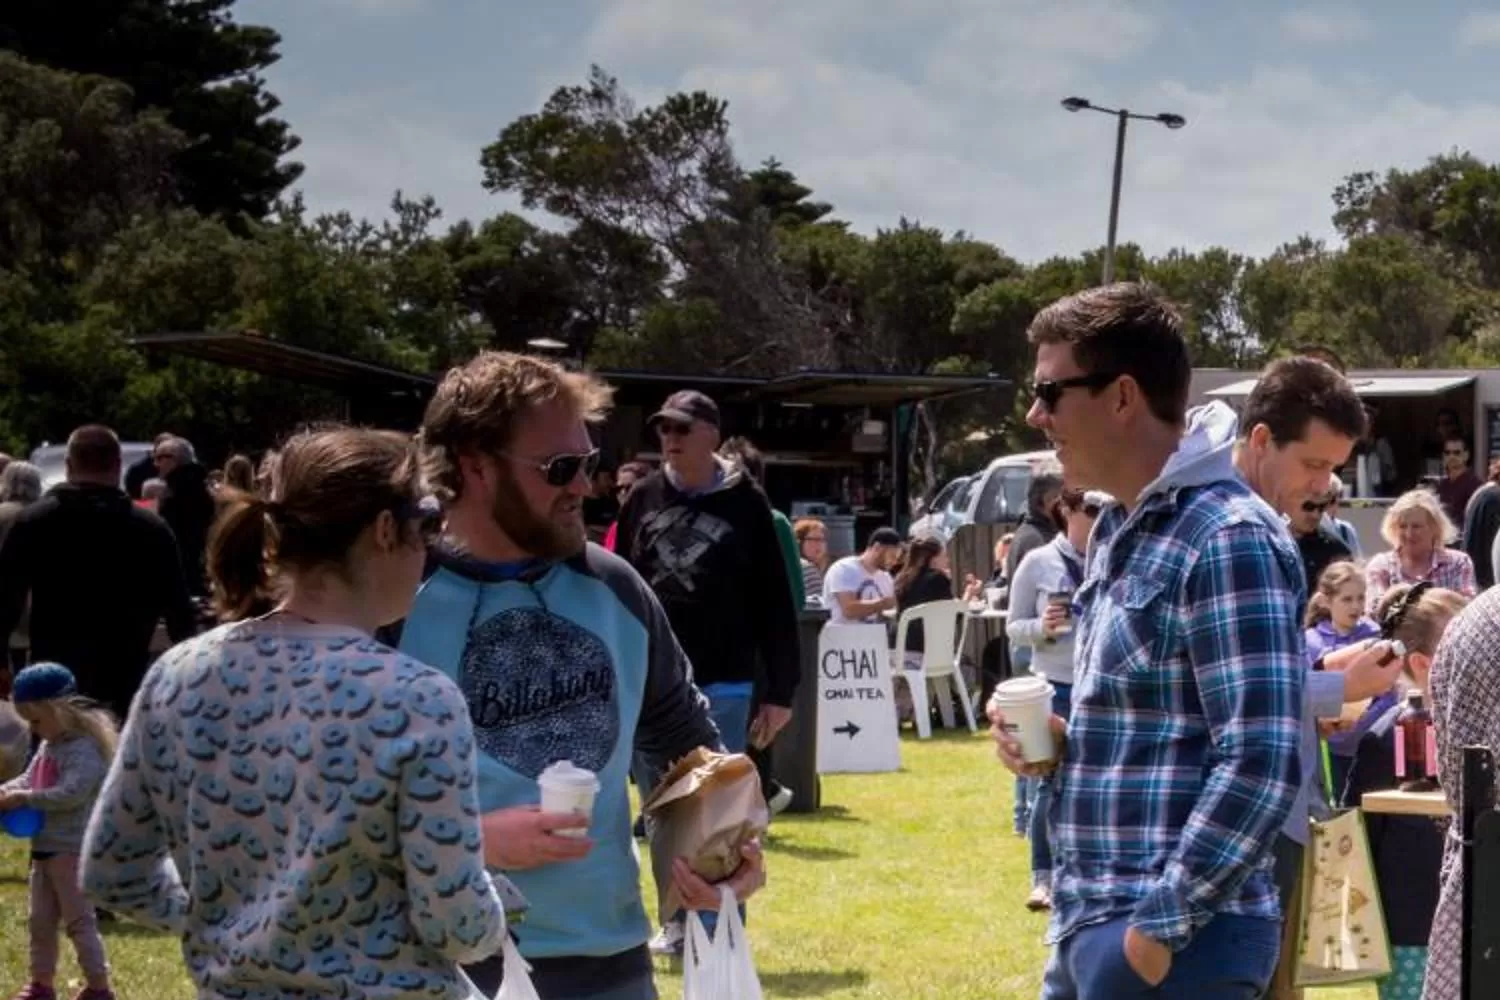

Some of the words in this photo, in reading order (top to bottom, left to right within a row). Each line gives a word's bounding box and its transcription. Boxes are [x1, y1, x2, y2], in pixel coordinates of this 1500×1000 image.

[822, 648, 878, 679] CHAI
[472, 667, 615, 728] Billabong
[856, 687, 884, 699] TEA
